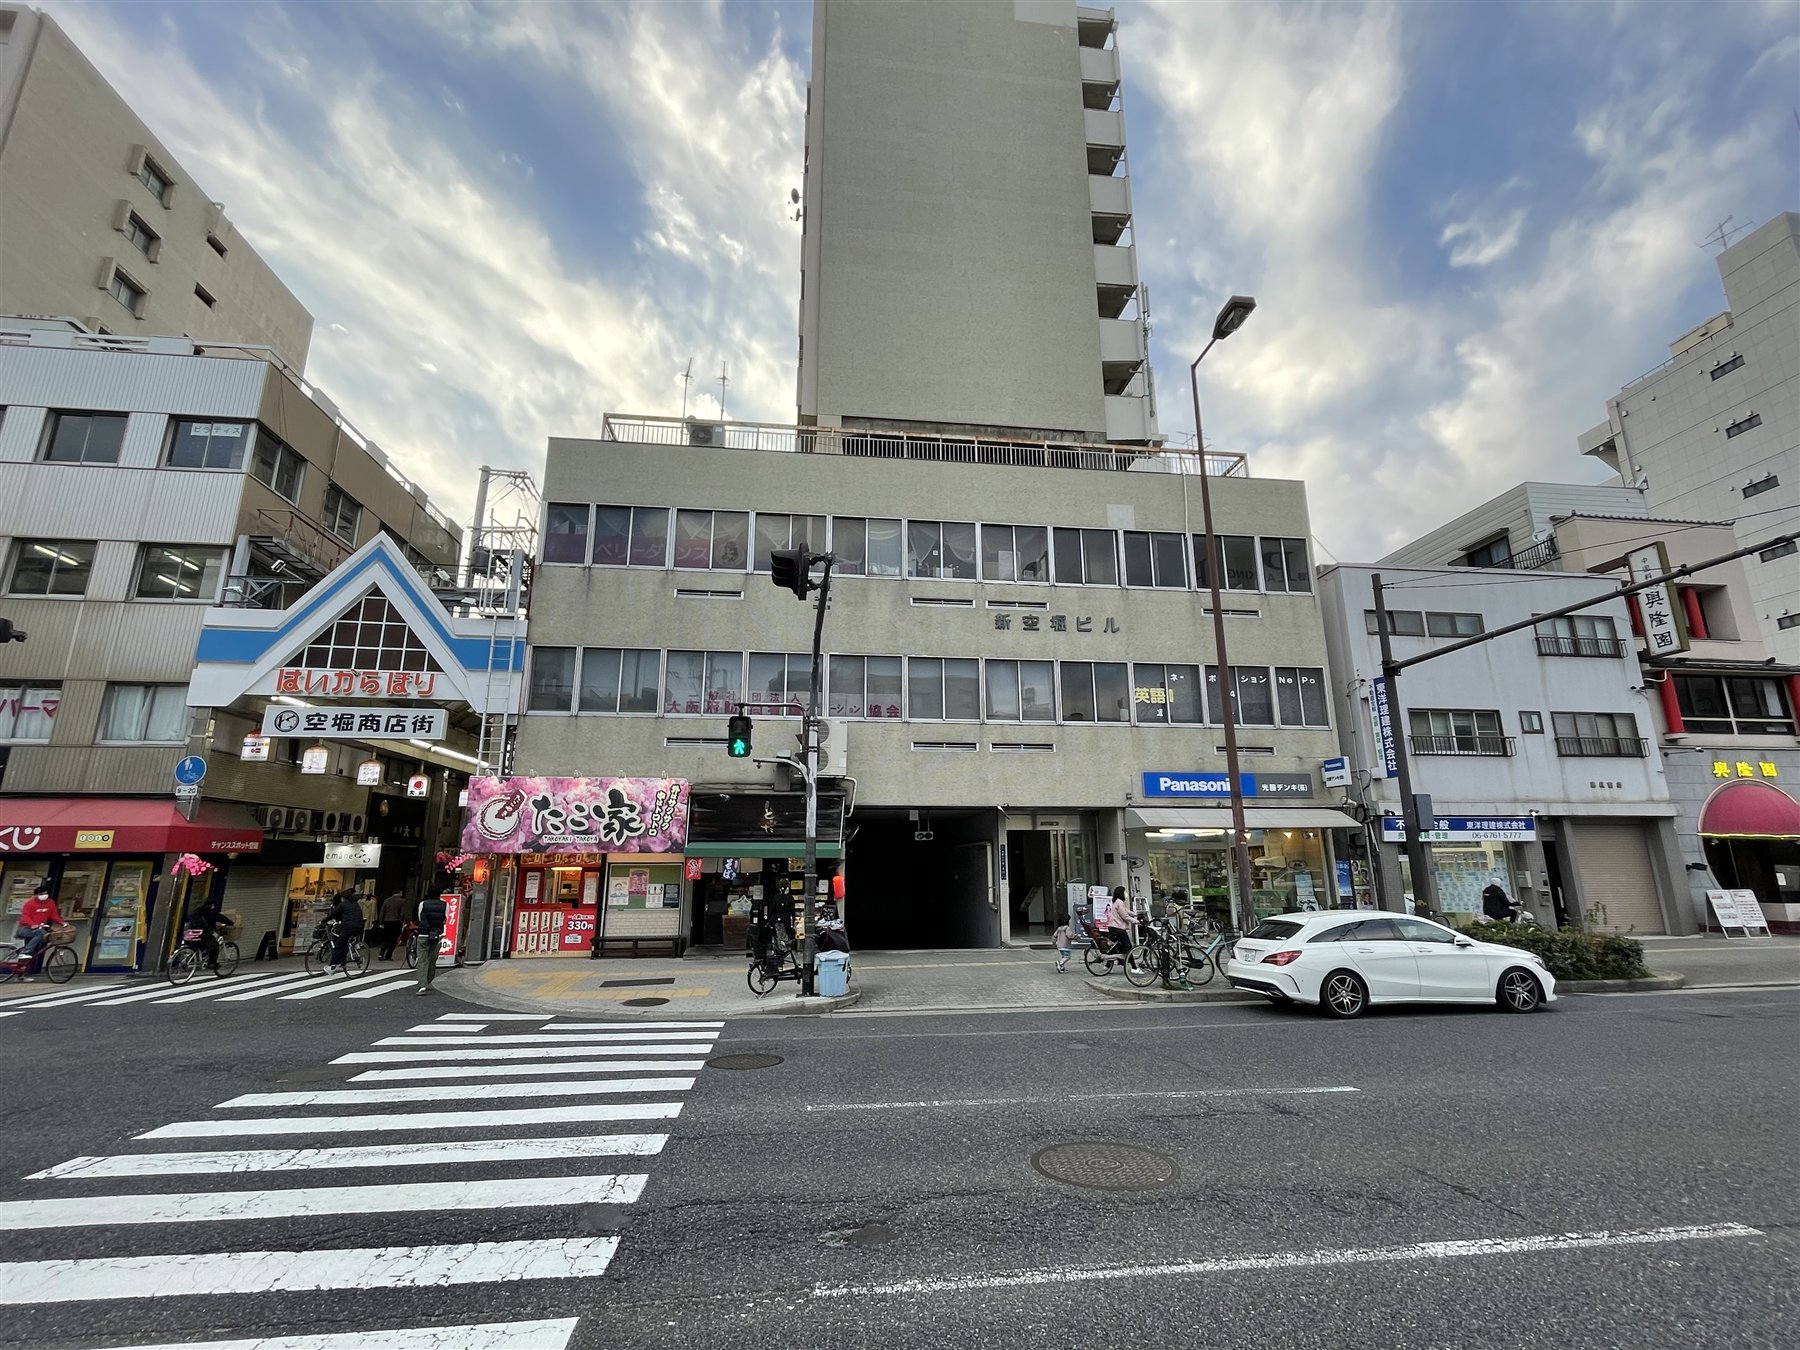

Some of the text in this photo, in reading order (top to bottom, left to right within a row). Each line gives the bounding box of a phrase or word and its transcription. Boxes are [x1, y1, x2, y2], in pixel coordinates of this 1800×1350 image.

[194, 425, 240, 434] ピラティス
[595, 543, 709, 560] ベリーダンス
[994, 613, 1120, 634] 新空堀ビル
[303, 711, 435, 734] 空堀商店街
[1375, 682, 1398, 771] 東洋理建株式会社
[1712, 761, 1778, 777] 興隆園
[1159, 777, 1231, 791] Panasoni
[529, 786, 645, 846] たこ家
[1465, 820, 1527, 830] 東洋理建株式会社
[1471, 831, 1523, 839] 06-6761-5777
[567, 920, 594, 931] 330円
